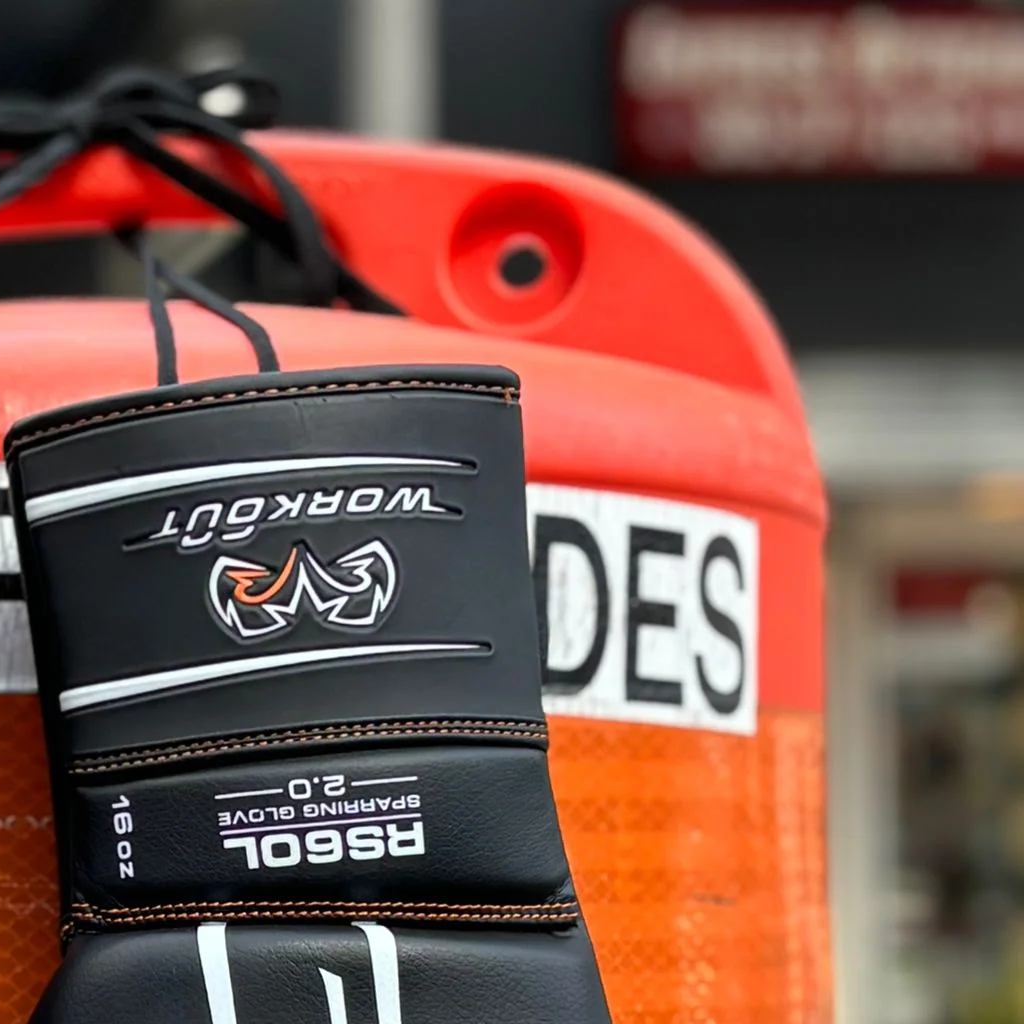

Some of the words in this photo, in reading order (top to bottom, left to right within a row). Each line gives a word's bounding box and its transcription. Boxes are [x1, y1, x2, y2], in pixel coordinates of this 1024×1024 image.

[148, 486, 446, 549] WORKOUT
[287, 774, 346, 800] 2.0
[111, 794, 133, 836] 16
[217, 806, 296, 827] GLOVE
[302, 794, 422, 818] SPARRING
[222, 820, 426, 870] RS60L
